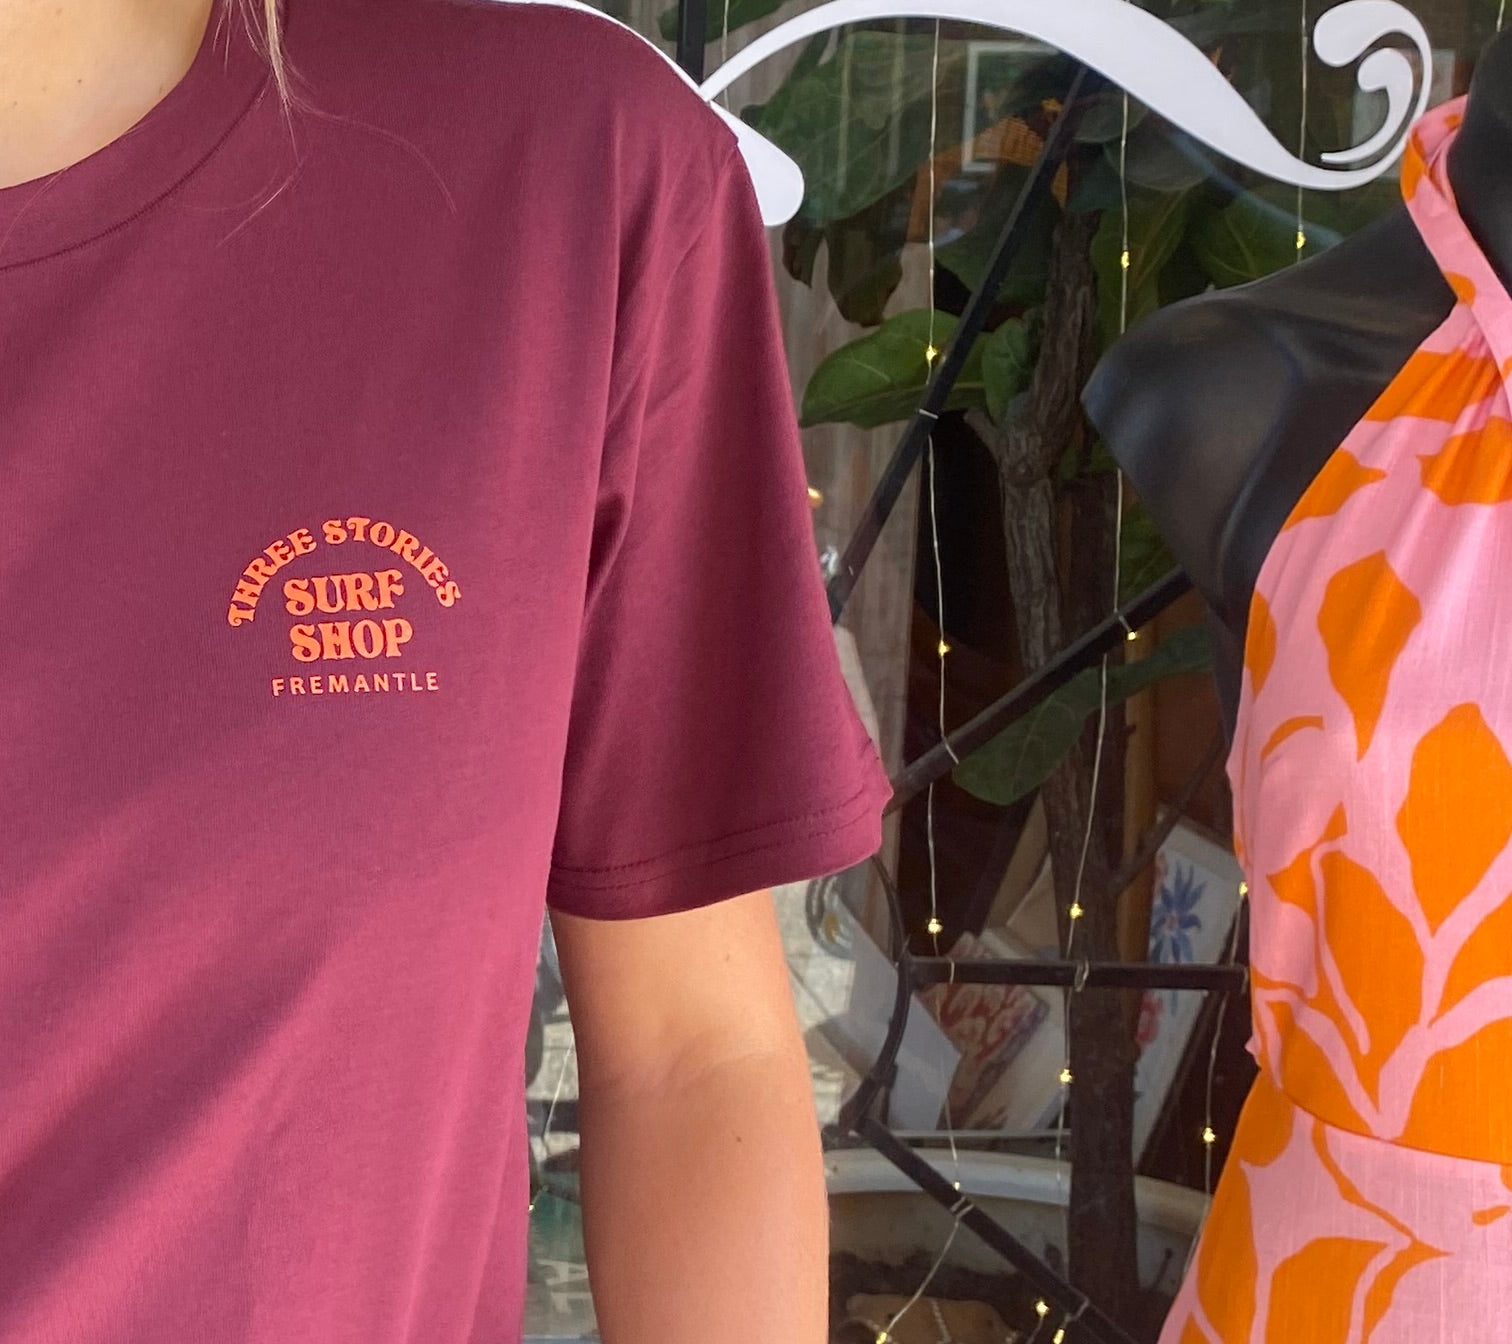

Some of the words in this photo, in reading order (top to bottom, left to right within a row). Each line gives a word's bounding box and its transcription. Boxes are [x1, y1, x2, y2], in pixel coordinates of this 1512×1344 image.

[227, 527, 317, 627] THREE
[322, 516, 462, 608] STORIES
[283, 569, 405, 616] SURF
[289, 618, 414, 663] SHOP
[272, 671, 440, 697] FREMANTLE
